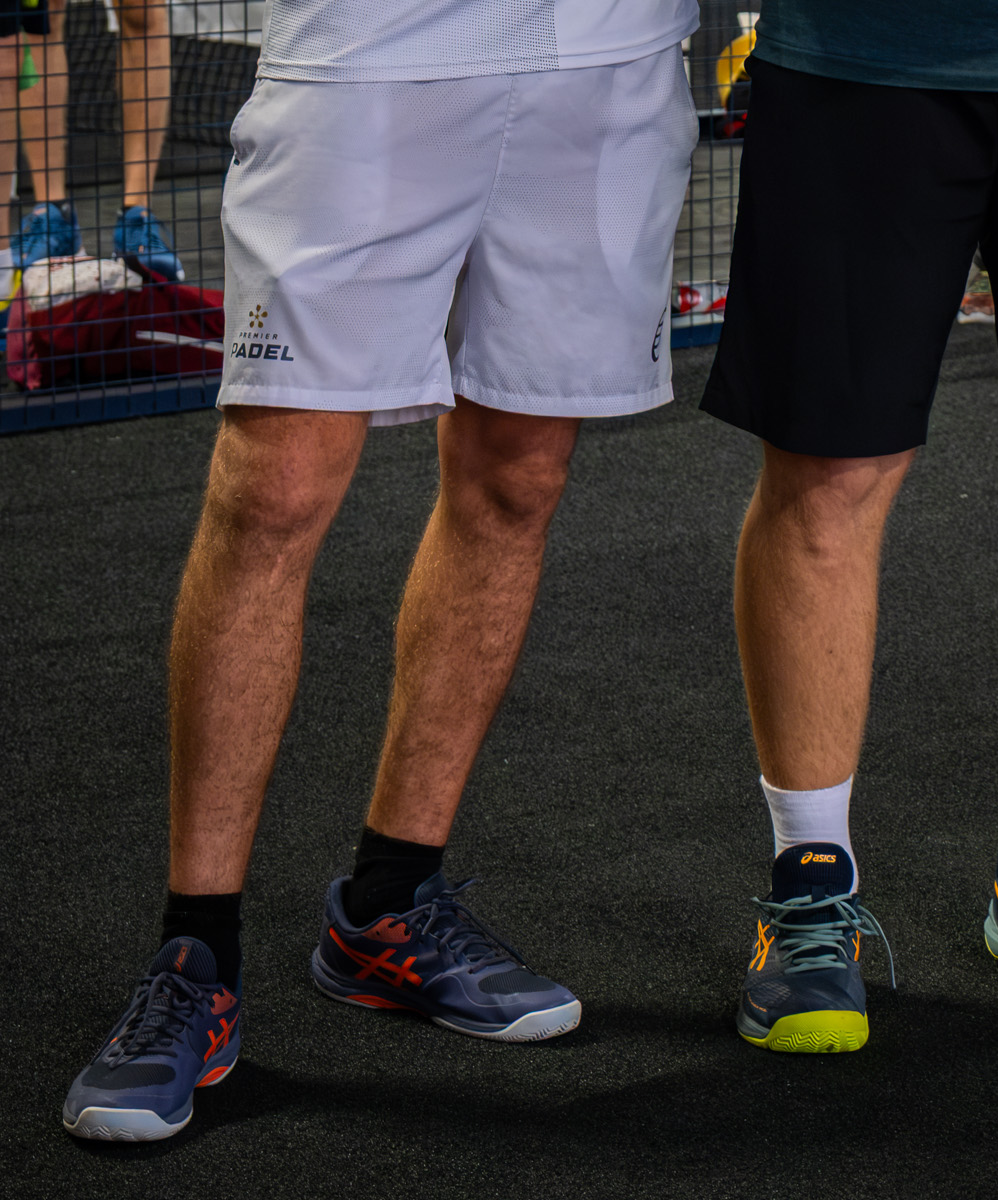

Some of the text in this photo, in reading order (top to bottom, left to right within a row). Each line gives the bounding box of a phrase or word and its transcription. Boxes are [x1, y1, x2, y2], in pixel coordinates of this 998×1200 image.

[239, 332, 278, 340] PREMIER
[231, 342, 294, 361] PADEL
[812, 854, 837, 863] asics
